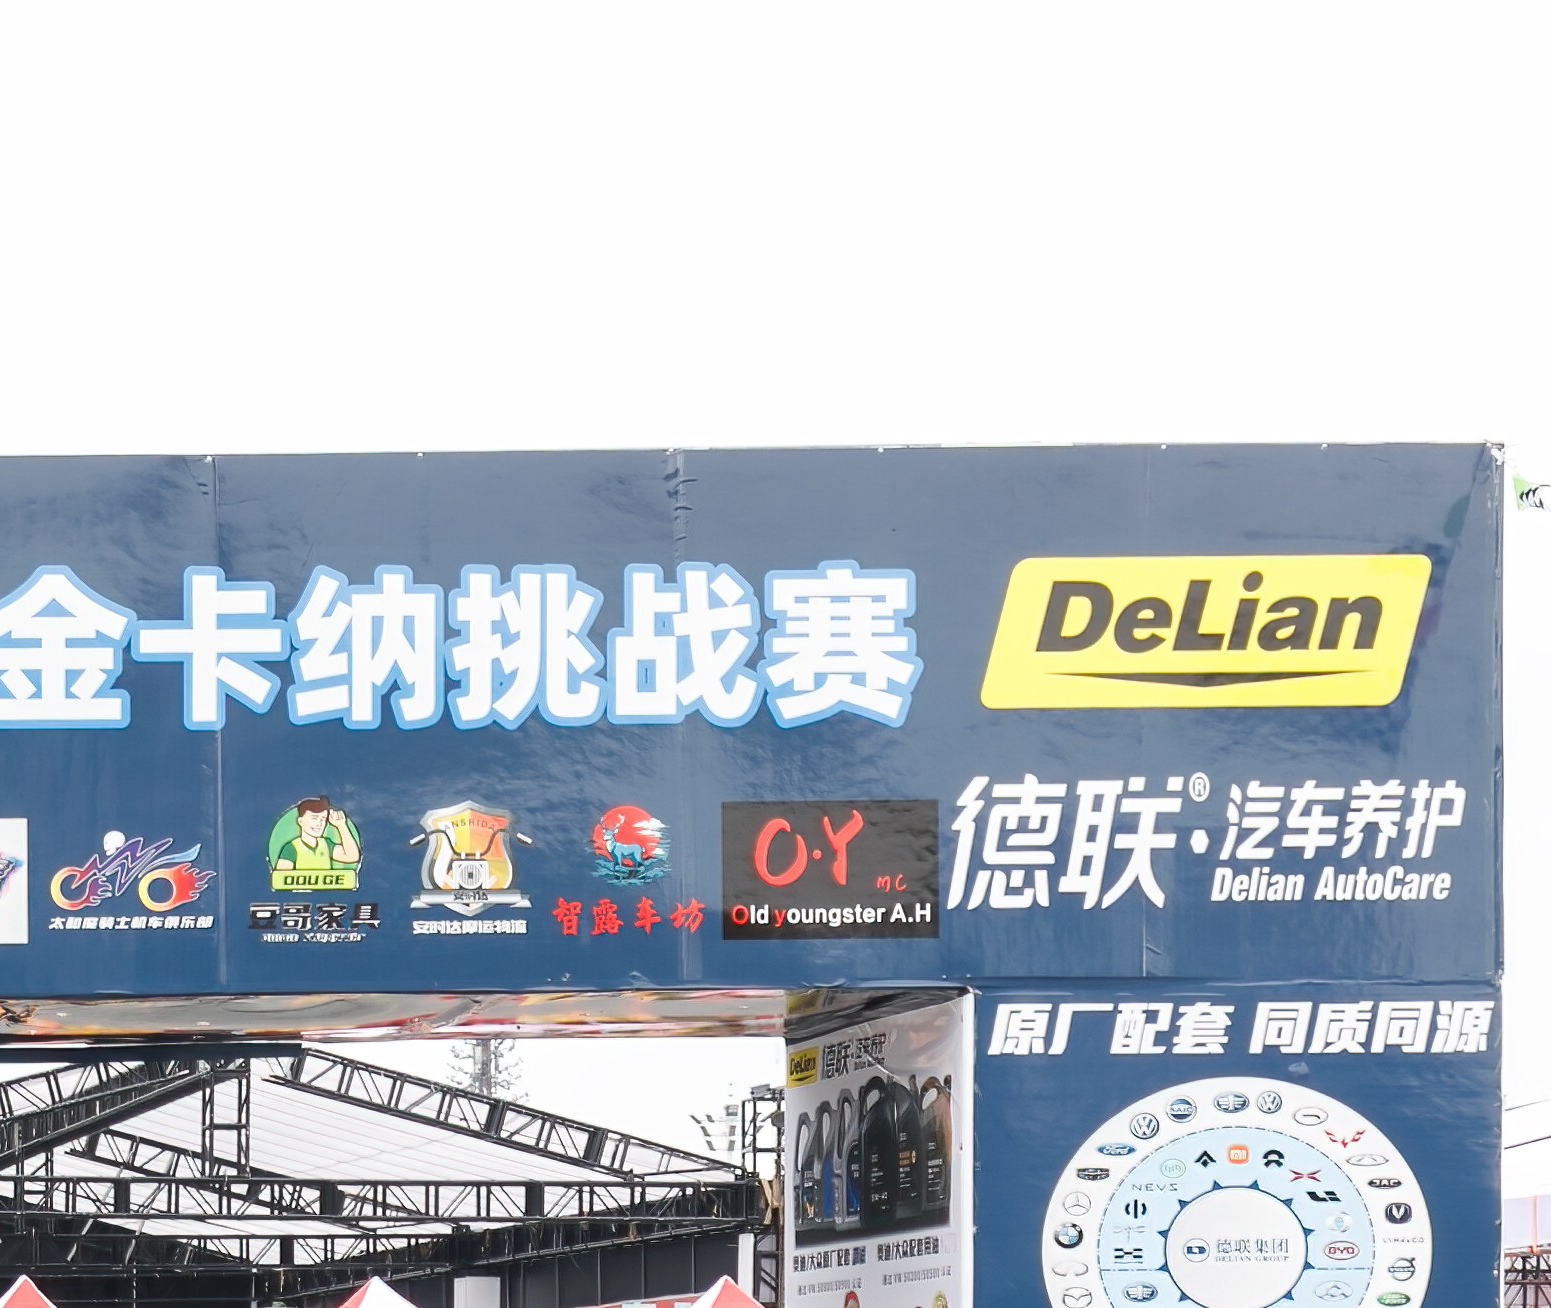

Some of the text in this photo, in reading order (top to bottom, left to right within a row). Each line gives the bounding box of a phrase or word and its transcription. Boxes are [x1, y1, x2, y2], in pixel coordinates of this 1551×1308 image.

[1035, 570, 1383, 654] DeLian
[1219, 778, 1467, 862] 汽车养护
[1211, 865, 1451, 903] Delian AutoCare
[731, 903, 932, 930] Old youngster A.H
[987, 1000, 1495, 1056] 原厂配套 同质同源
[1214, 1255, 1252, 1263] DELIAN
[1215, 1237, 1290, 1255] 德联集团
